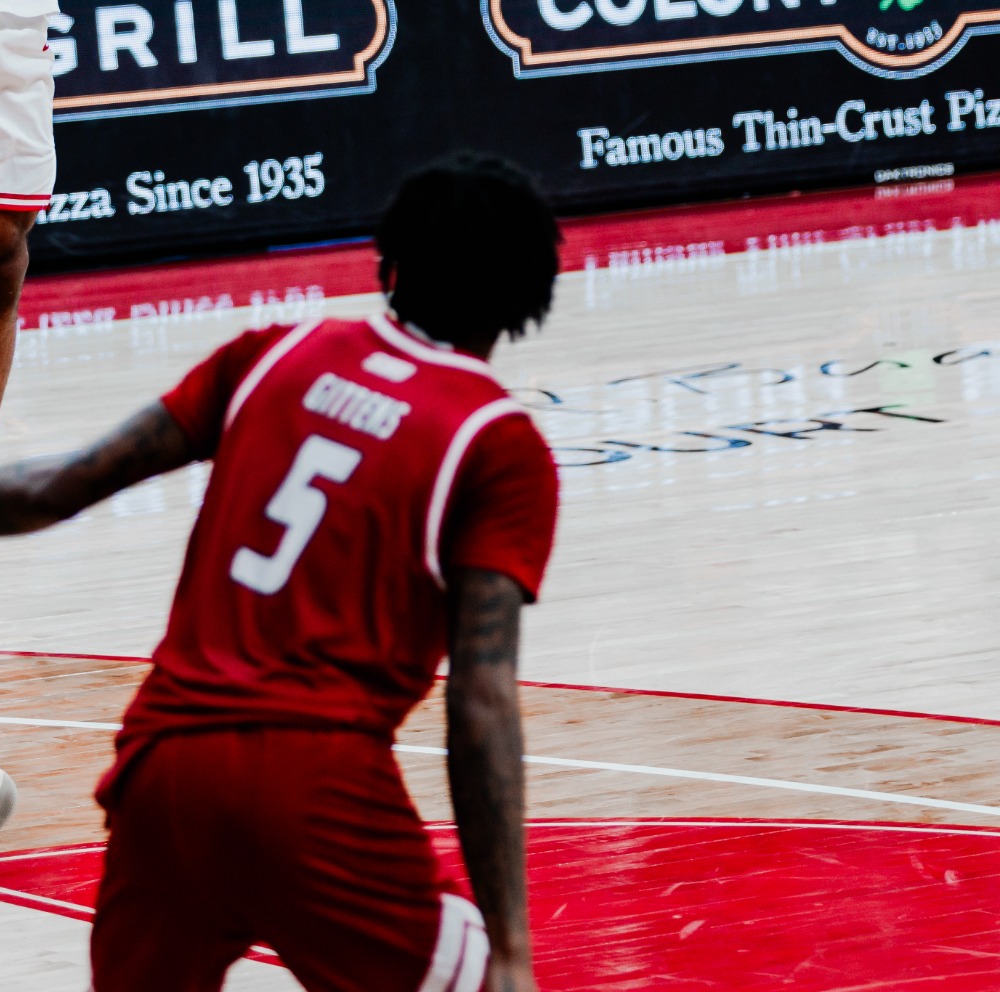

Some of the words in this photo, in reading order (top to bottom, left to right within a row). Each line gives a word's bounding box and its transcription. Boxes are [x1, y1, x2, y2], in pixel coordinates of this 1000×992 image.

[577, 127, 724, 169] Famous
[733, 99, 936, 152] Thin-Crust
[126, 170, 233, 215] Since
[243, 152, 325, 203] 1935
[229, 433, 363, 595] 5
